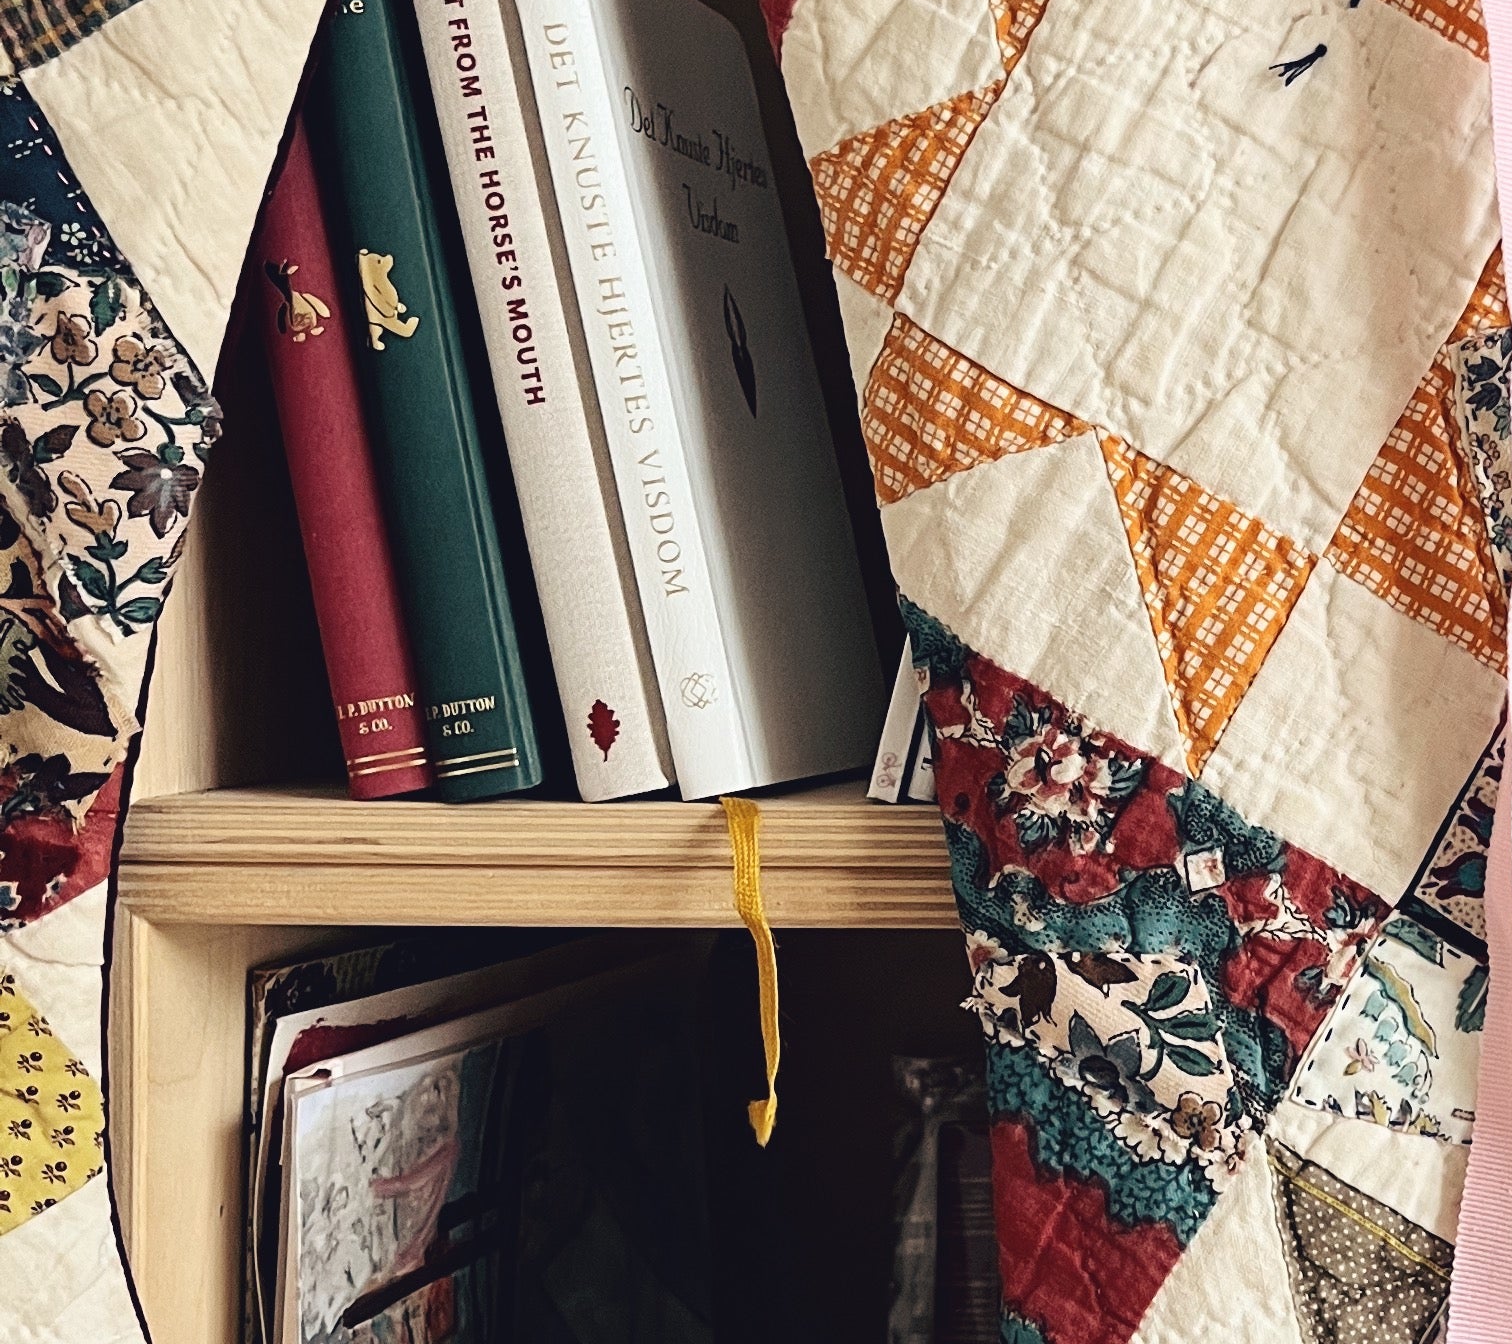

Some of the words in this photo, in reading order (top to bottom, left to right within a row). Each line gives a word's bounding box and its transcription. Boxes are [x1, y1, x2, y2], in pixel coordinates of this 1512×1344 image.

[448, 18, 482, 99] FROM
[465, 105, 495, 162] THE
[479, 169, 521, 291] HORSE'S
[506, 298, 546, 407] MOUTH
[543, 23, 581, 93] DET
[564, 113, 616, 262] KNUSTE
[597, 275, 654, 435] HJERTES
[636, 448, 689, 598] VISDOM
